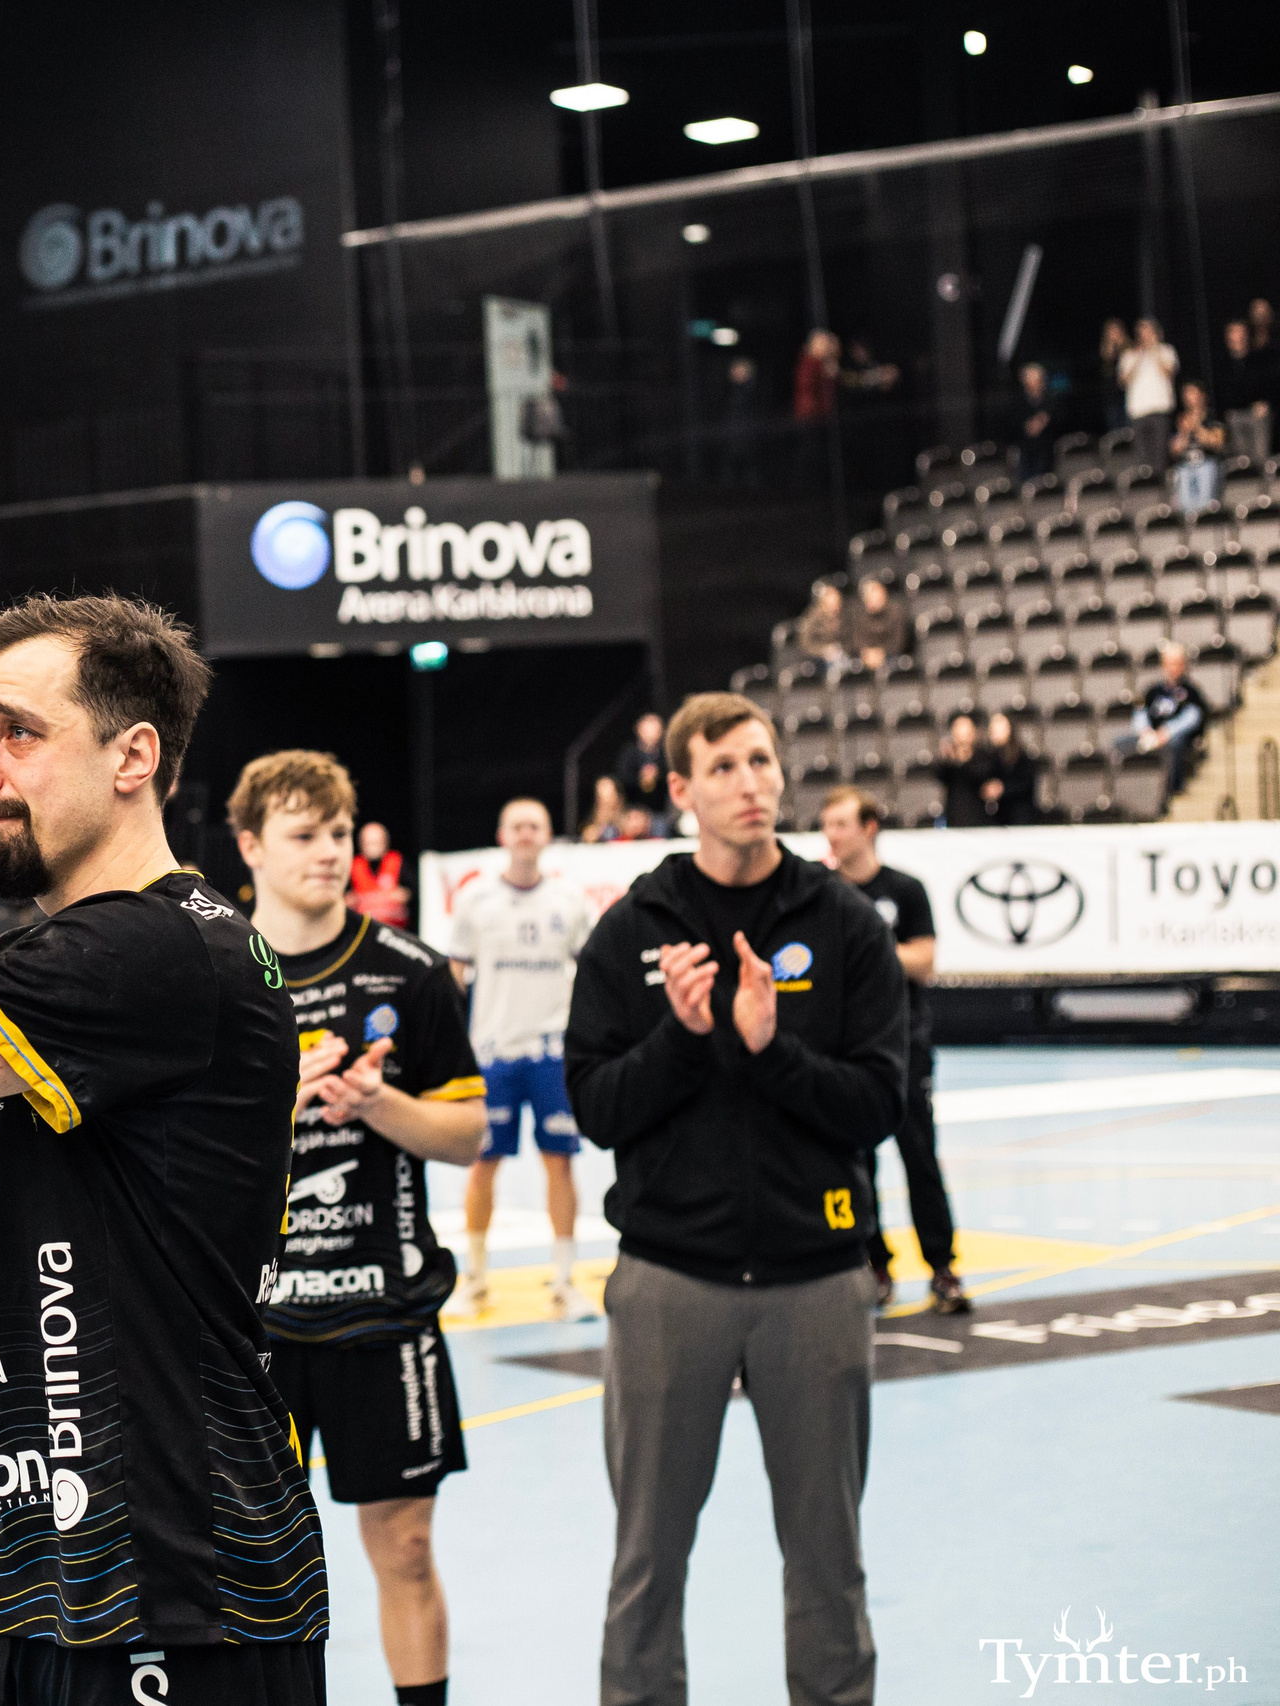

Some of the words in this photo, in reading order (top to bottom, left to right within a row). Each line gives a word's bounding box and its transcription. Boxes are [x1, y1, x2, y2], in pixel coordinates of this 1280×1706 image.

[86, 196, 305, 281] Brinova
[332, 506, 593, 583] Brinova
[1140, 849, 1278, 911] Toyo
[287, 1202, 374, 1235] ORDSON
[824, 1187, 855, 1230] 13
[38, 1242, 82, 1458] Brinova
